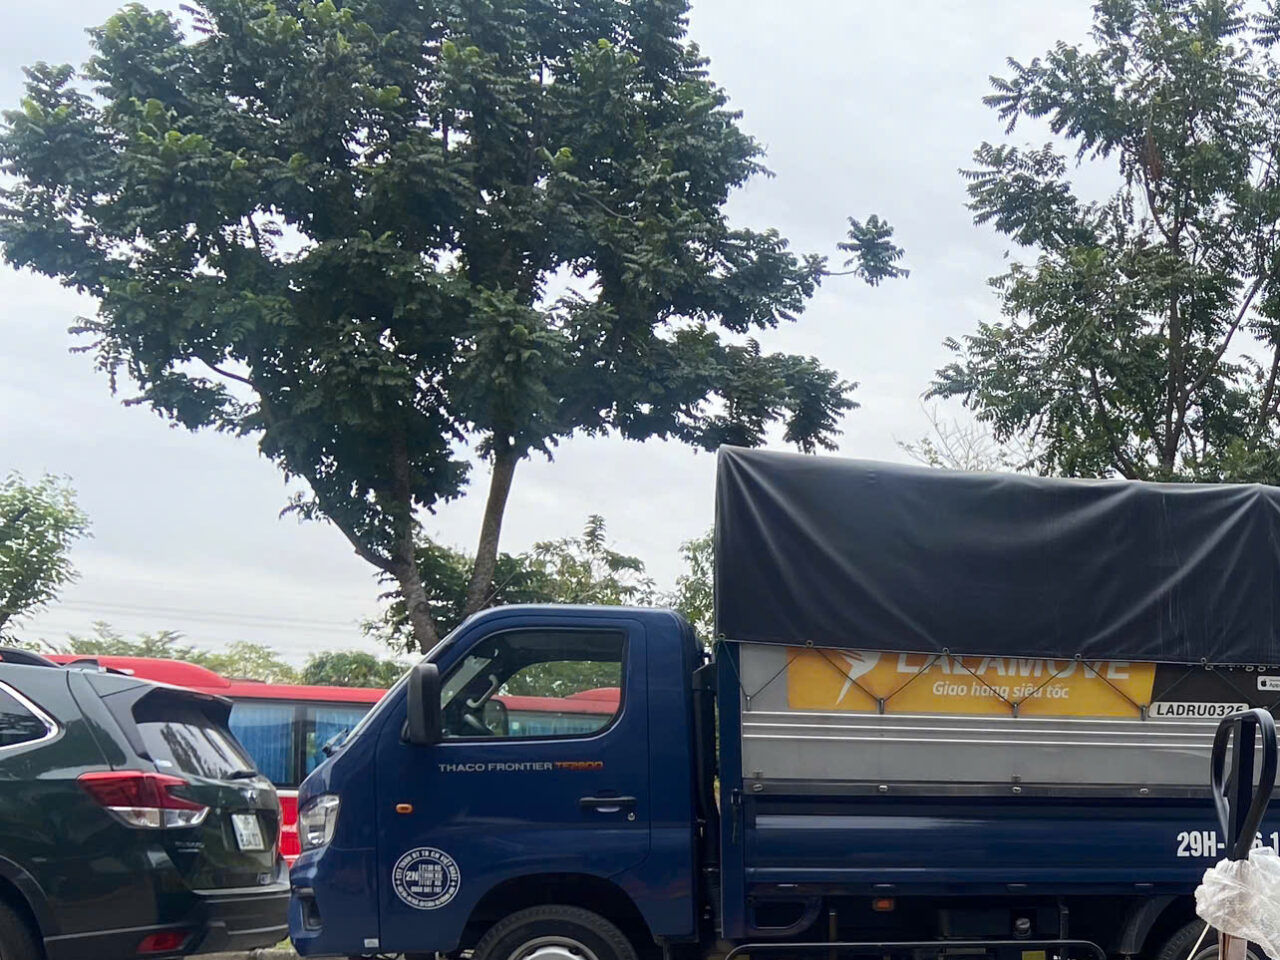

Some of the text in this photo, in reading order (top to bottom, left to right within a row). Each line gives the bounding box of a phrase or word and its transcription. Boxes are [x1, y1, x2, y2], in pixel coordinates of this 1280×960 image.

[932, 681, 967, 696] Giao
[438, 763, 485, 772] THACO
[488, 762, 553, 772] FRONTIER
